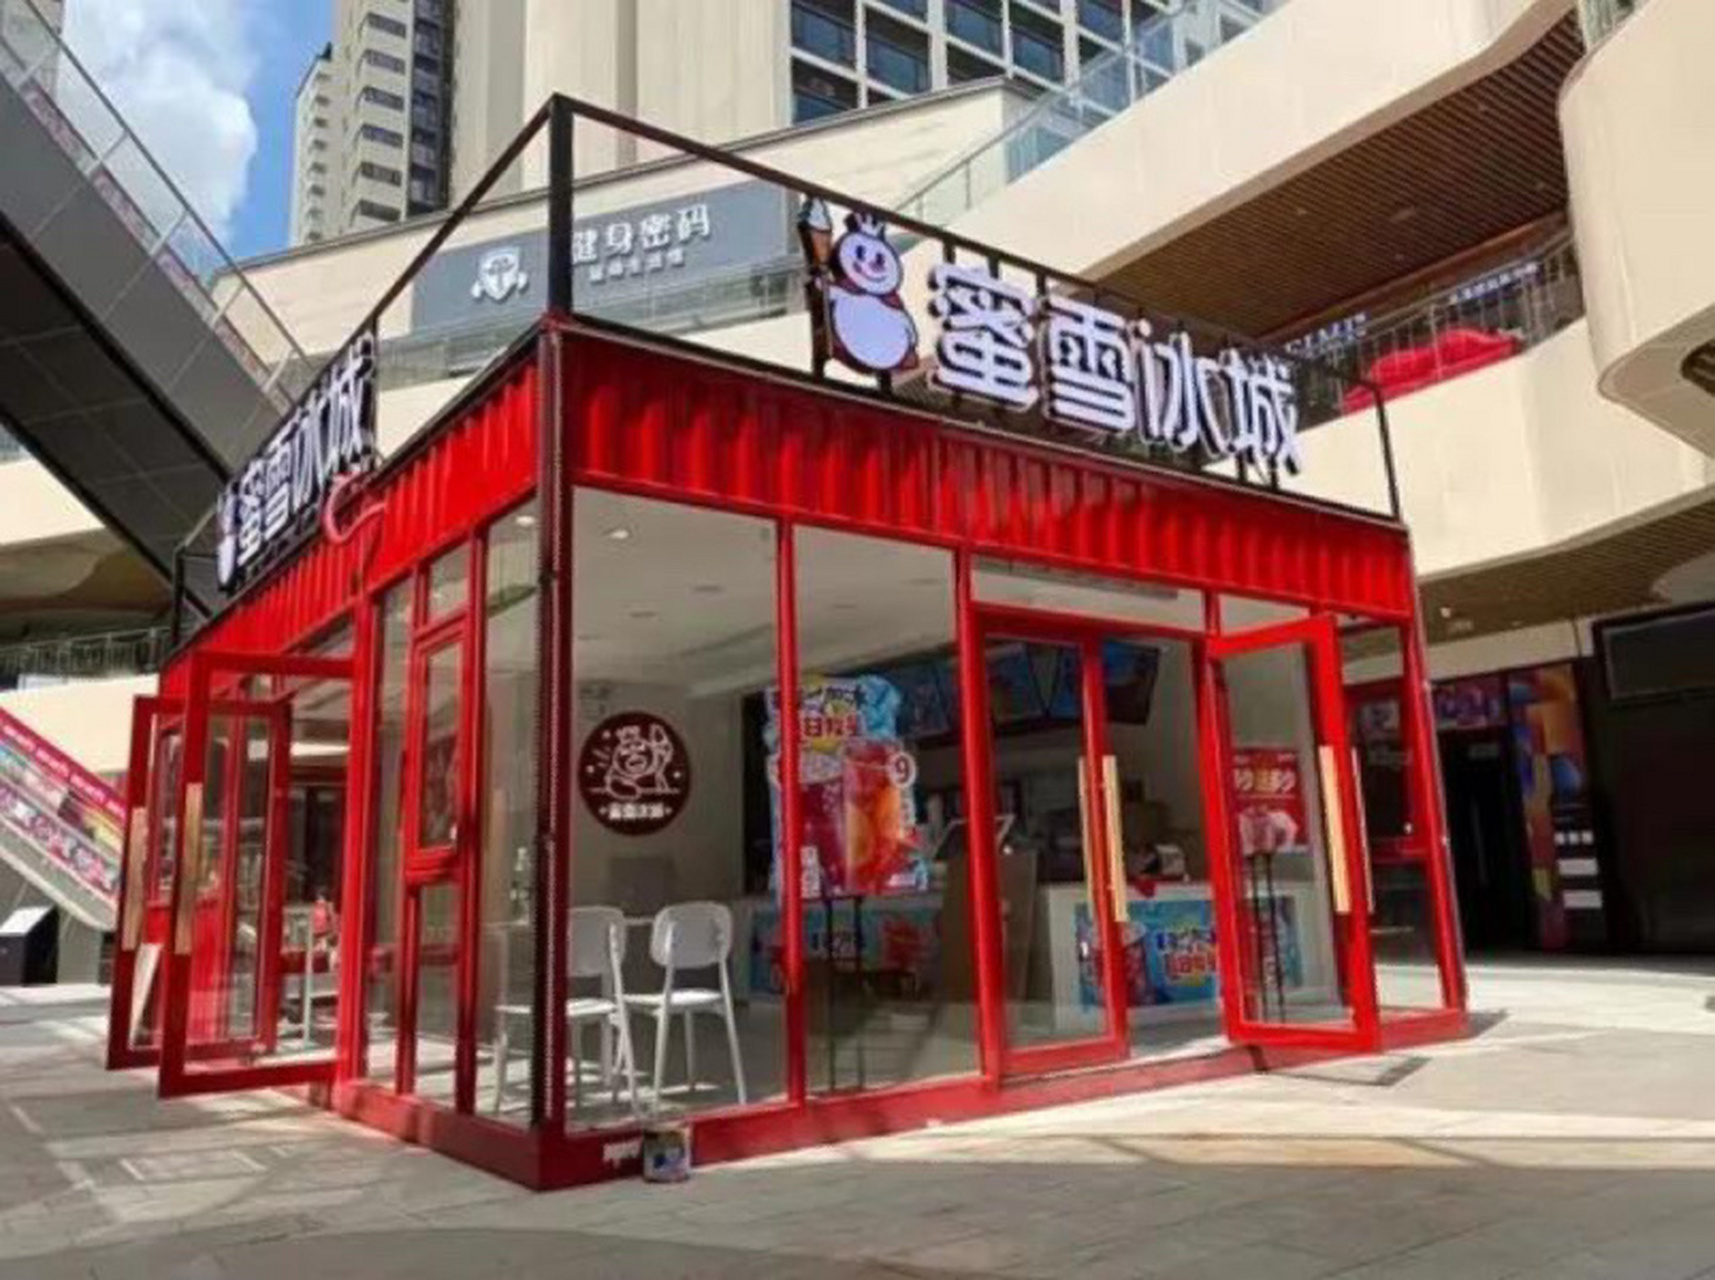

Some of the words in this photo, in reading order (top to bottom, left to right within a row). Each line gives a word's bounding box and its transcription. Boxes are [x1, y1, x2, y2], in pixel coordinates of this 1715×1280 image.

[571, 204, 710, 264] 健身密码
[928, 261, 1301, 474] 蜜雪冰城
